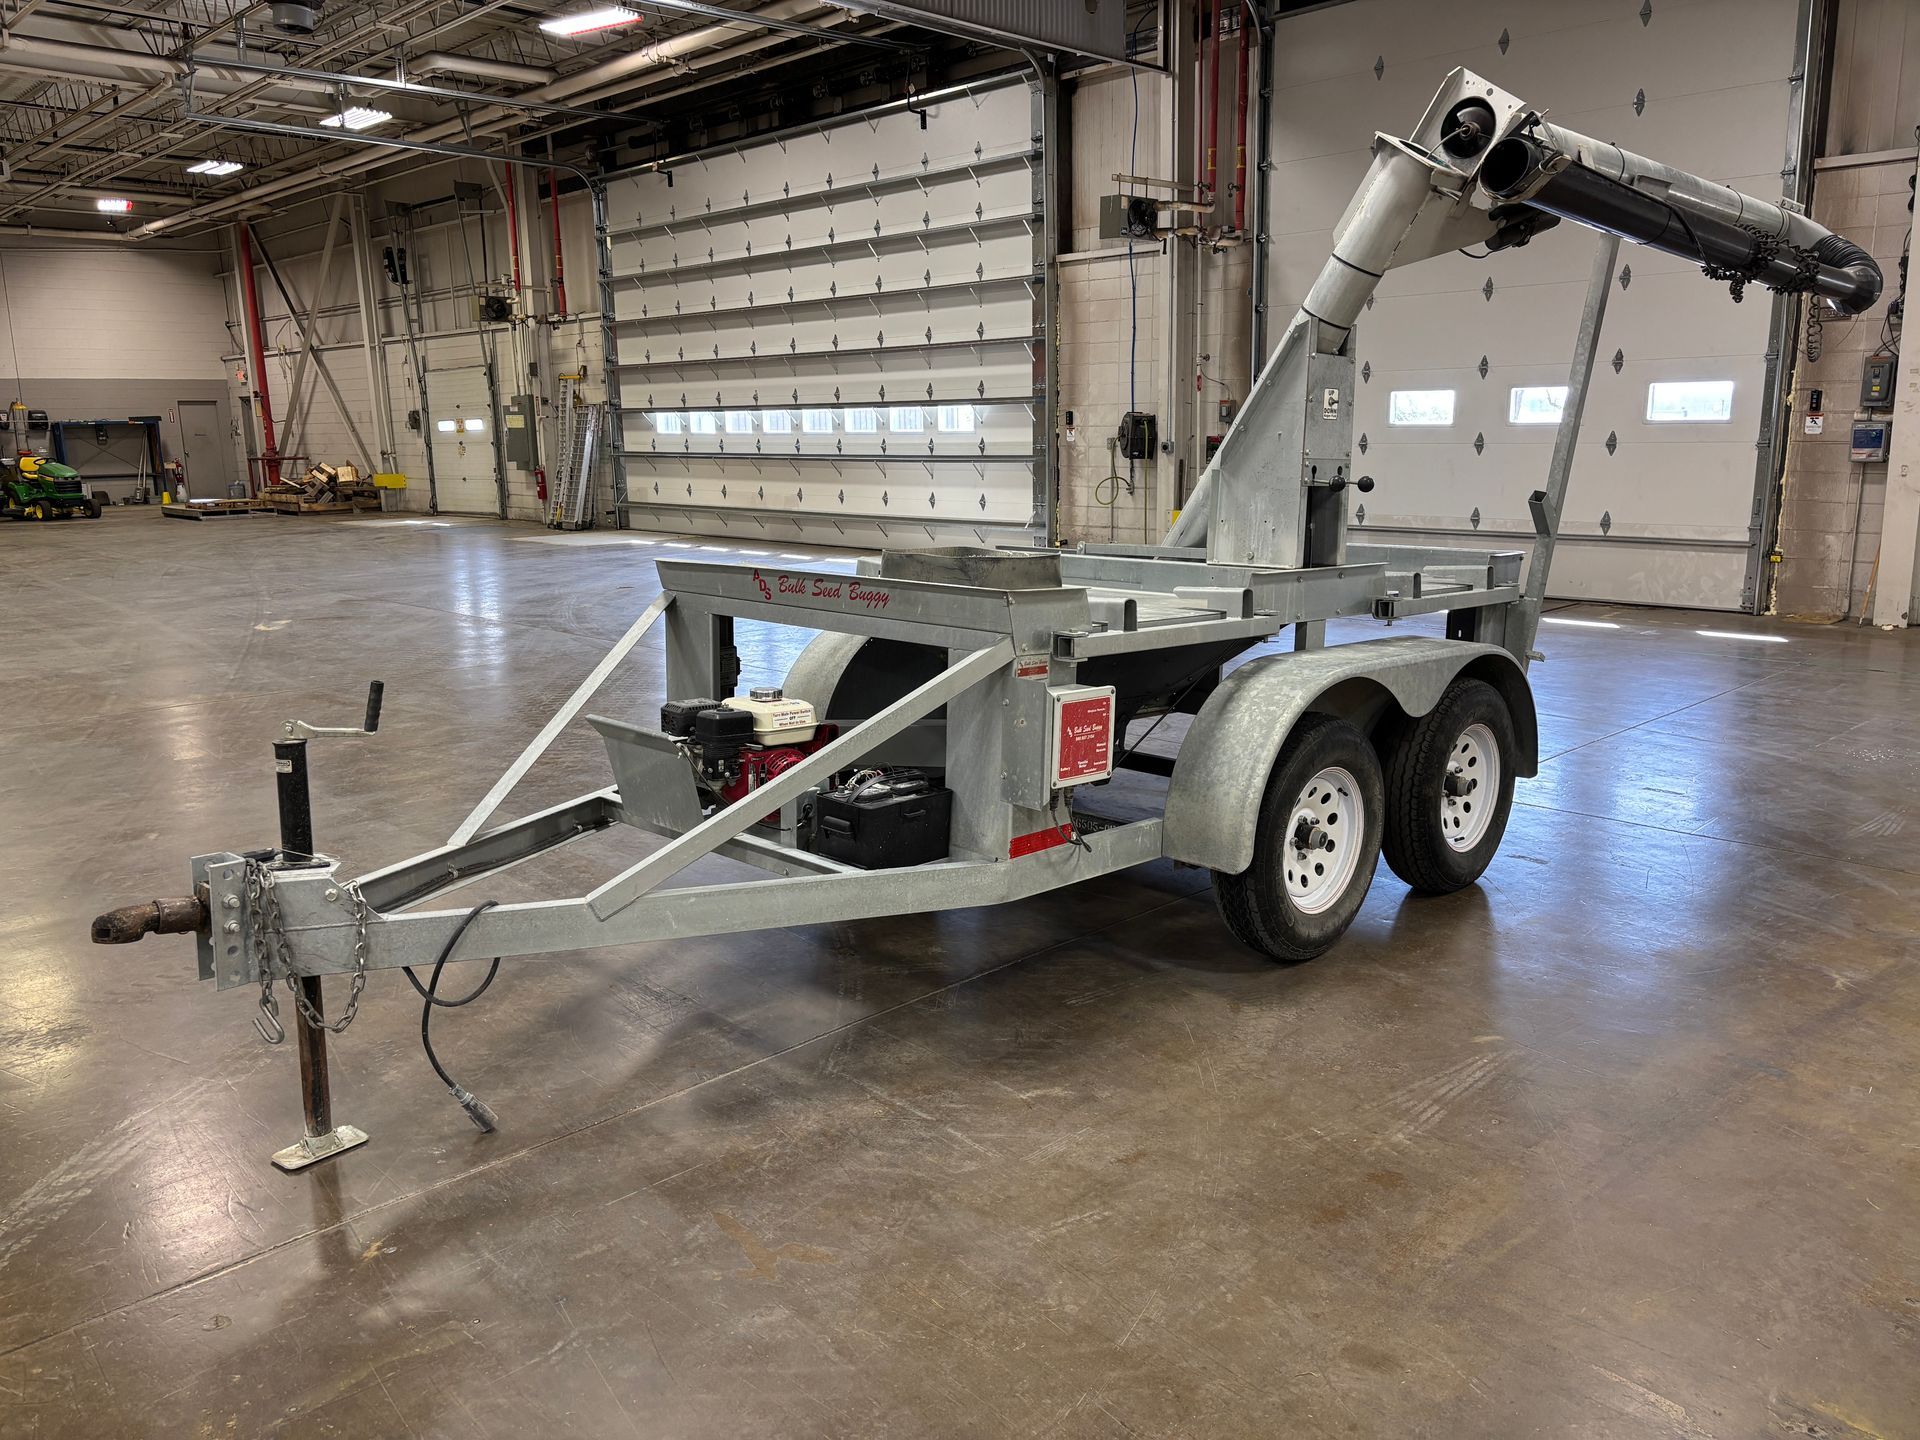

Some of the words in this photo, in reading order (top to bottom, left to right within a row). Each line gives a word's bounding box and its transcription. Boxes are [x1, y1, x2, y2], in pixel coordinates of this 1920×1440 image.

[778, 574, 807, 595] Bulk
[811, 578, 842, 598] Seed
[849, 581, 891, 608] Buggy
